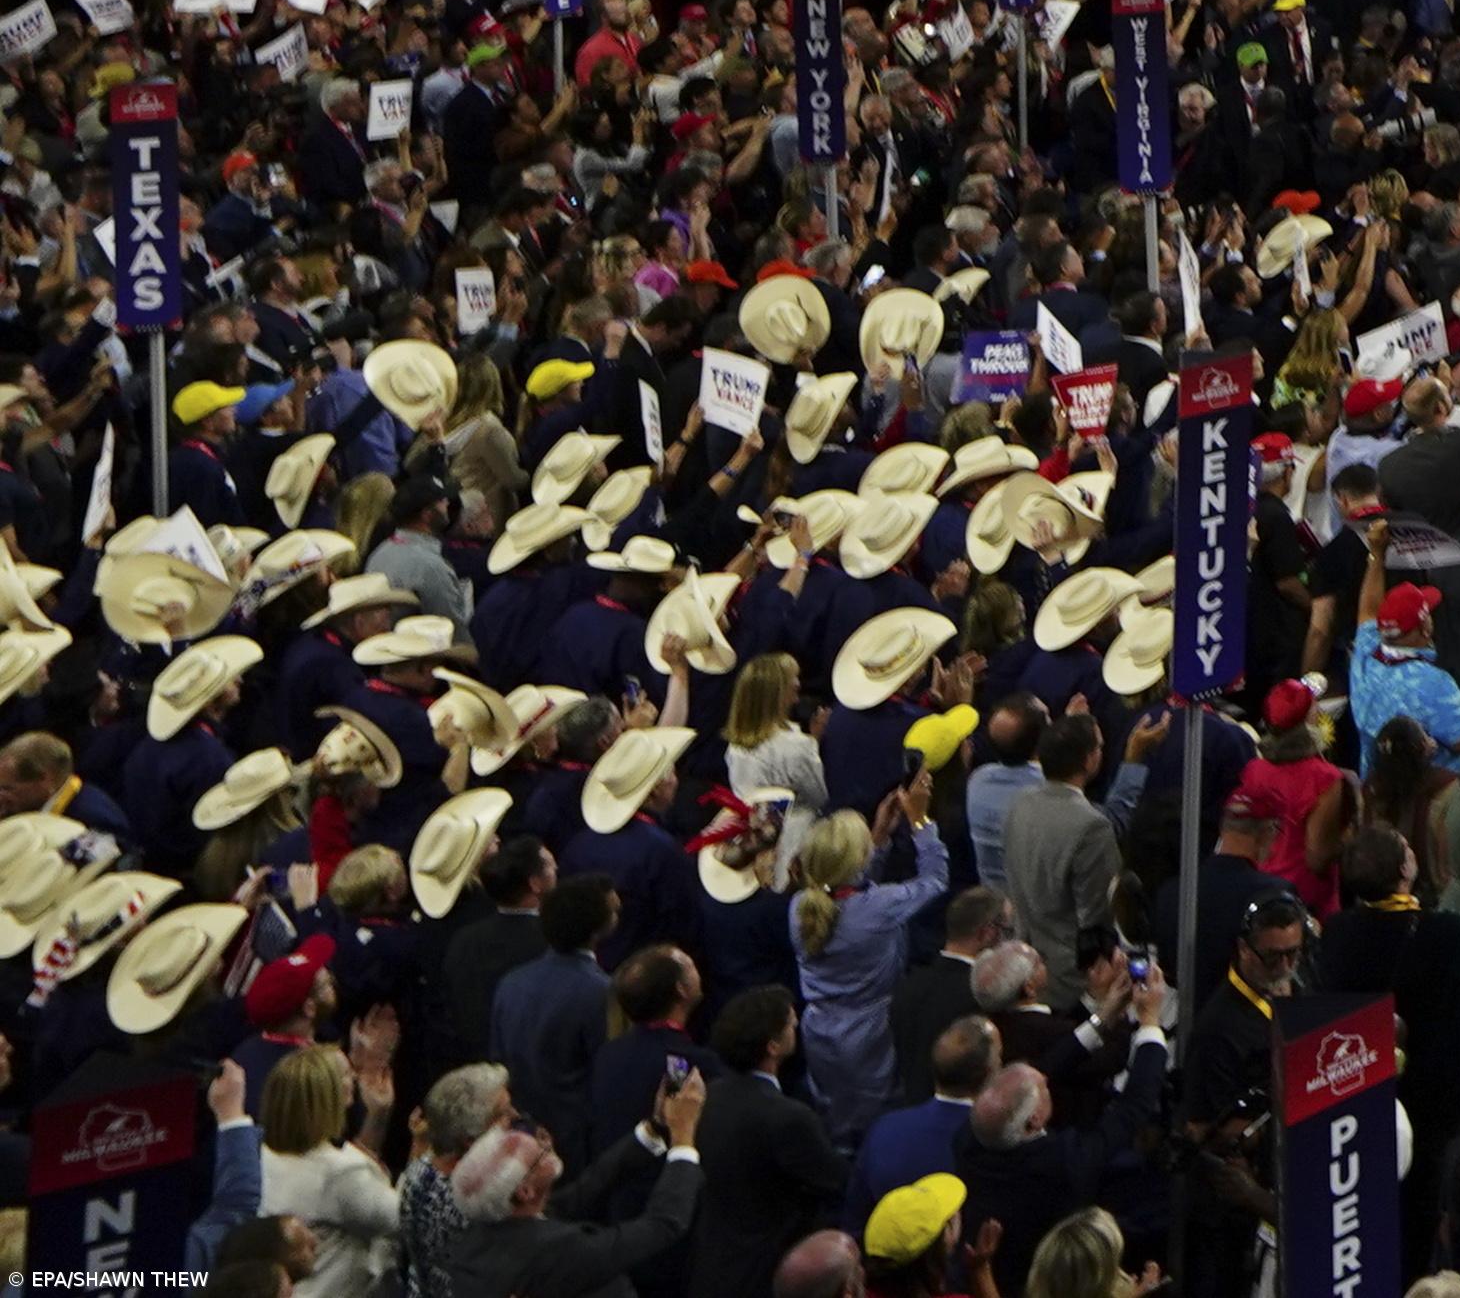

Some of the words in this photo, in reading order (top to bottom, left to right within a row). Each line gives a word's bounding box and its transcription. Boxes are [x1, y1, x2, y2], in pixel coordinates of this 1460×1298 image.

[1130, 17, 1149, 73] WEST
[810, 67, 833, 155] YORK
[1135, 75, 1154, 184] VIRGINIA
[128, 137, 168, 310] TEXAS
[1195, 417, 1229, 677] KENTUCKY
